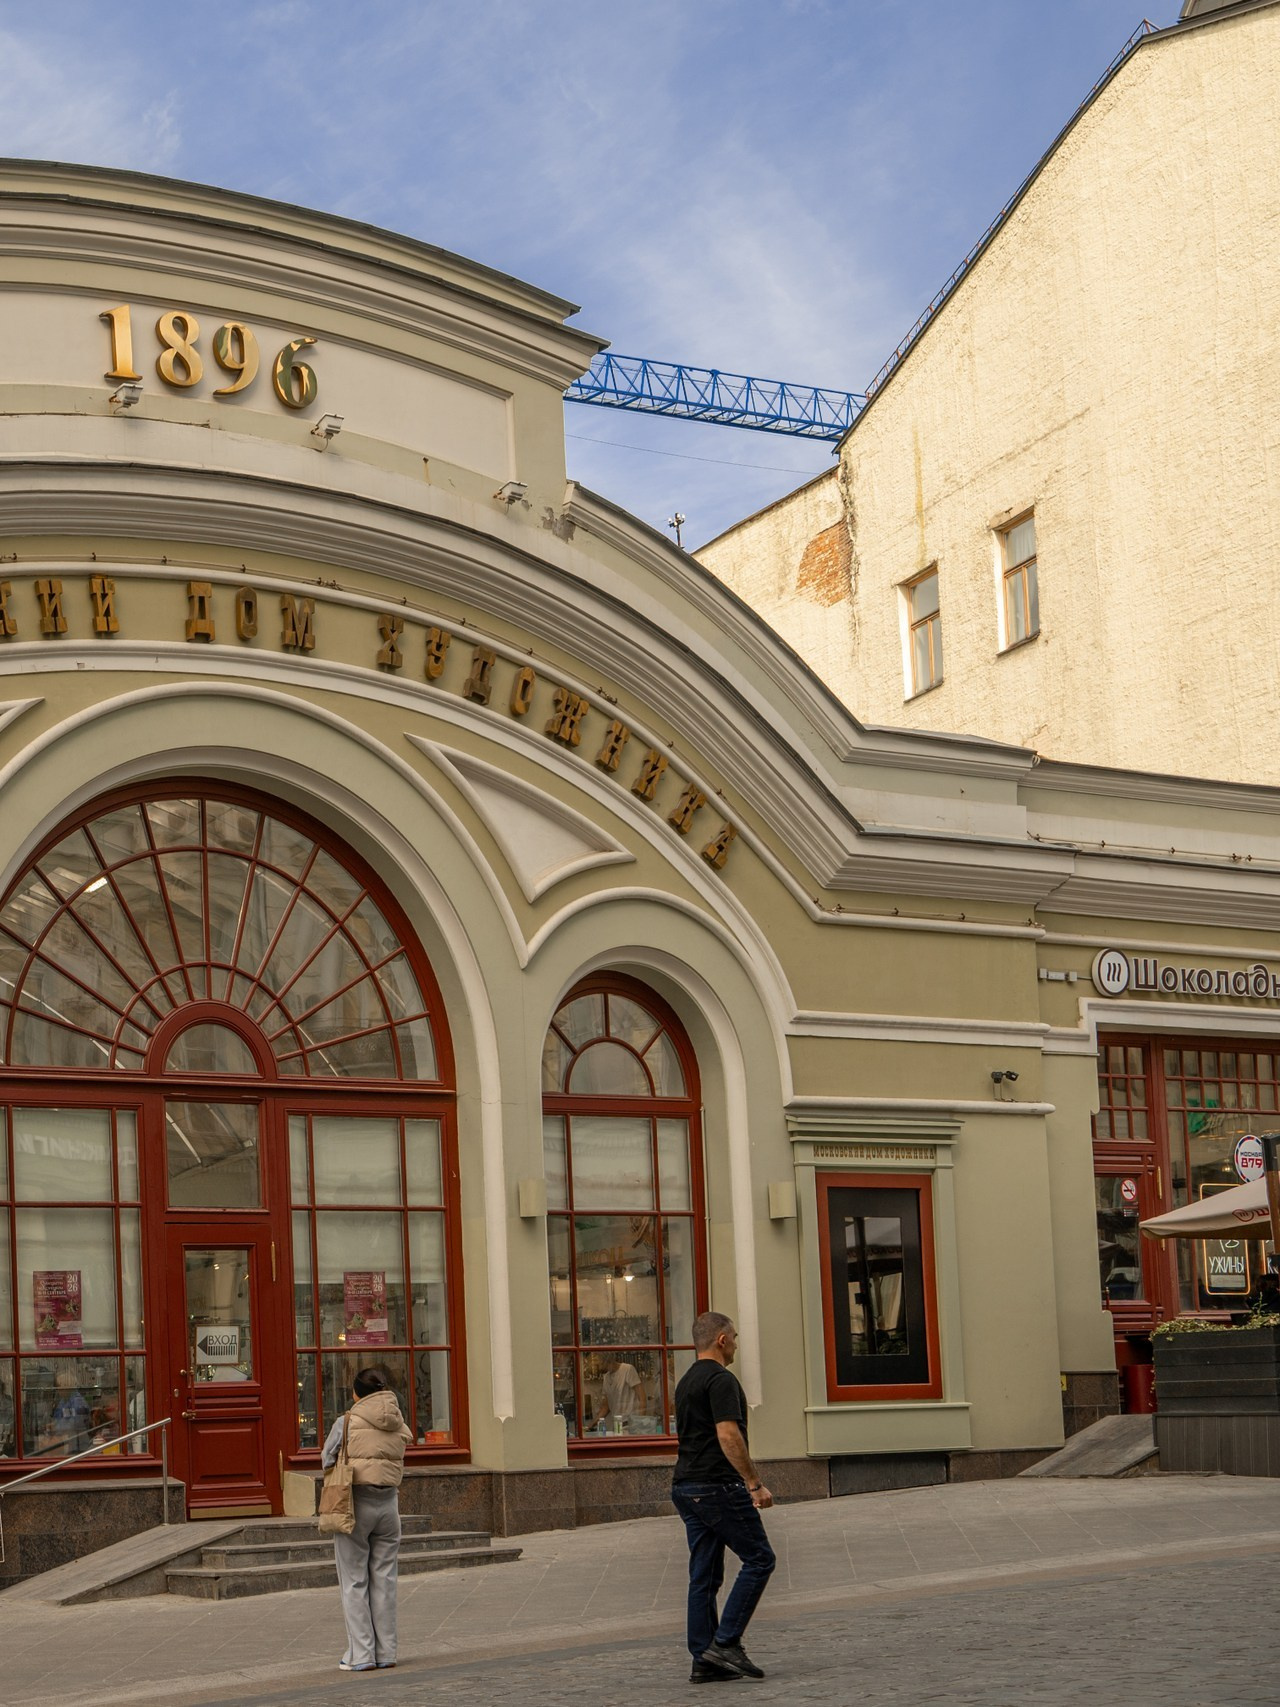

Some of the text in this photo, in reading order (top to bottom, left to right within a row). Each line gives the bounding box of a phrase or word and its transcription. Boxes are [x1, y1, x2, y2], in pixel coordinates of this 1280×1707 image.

[99, 304, 318, 409] 1896
[185, 581, 316, 651] ДОМ
[376, 614, 740, 870] ХУДОЖНИКА
[865, 1145, 883, 1160] ДОМ
[1240, 1158, 1263, 1169] 879
[1208, 1256, 1245, 1274] УЖИНЫ
[67, 1274, 78, 1283] 20
[373, 1274, 383, 1283] 20
[67, 1283, 78, 1292] 26
[373, 1283, 383, 1292] 26
[208, 1335, 237, 1346] ВХОД
